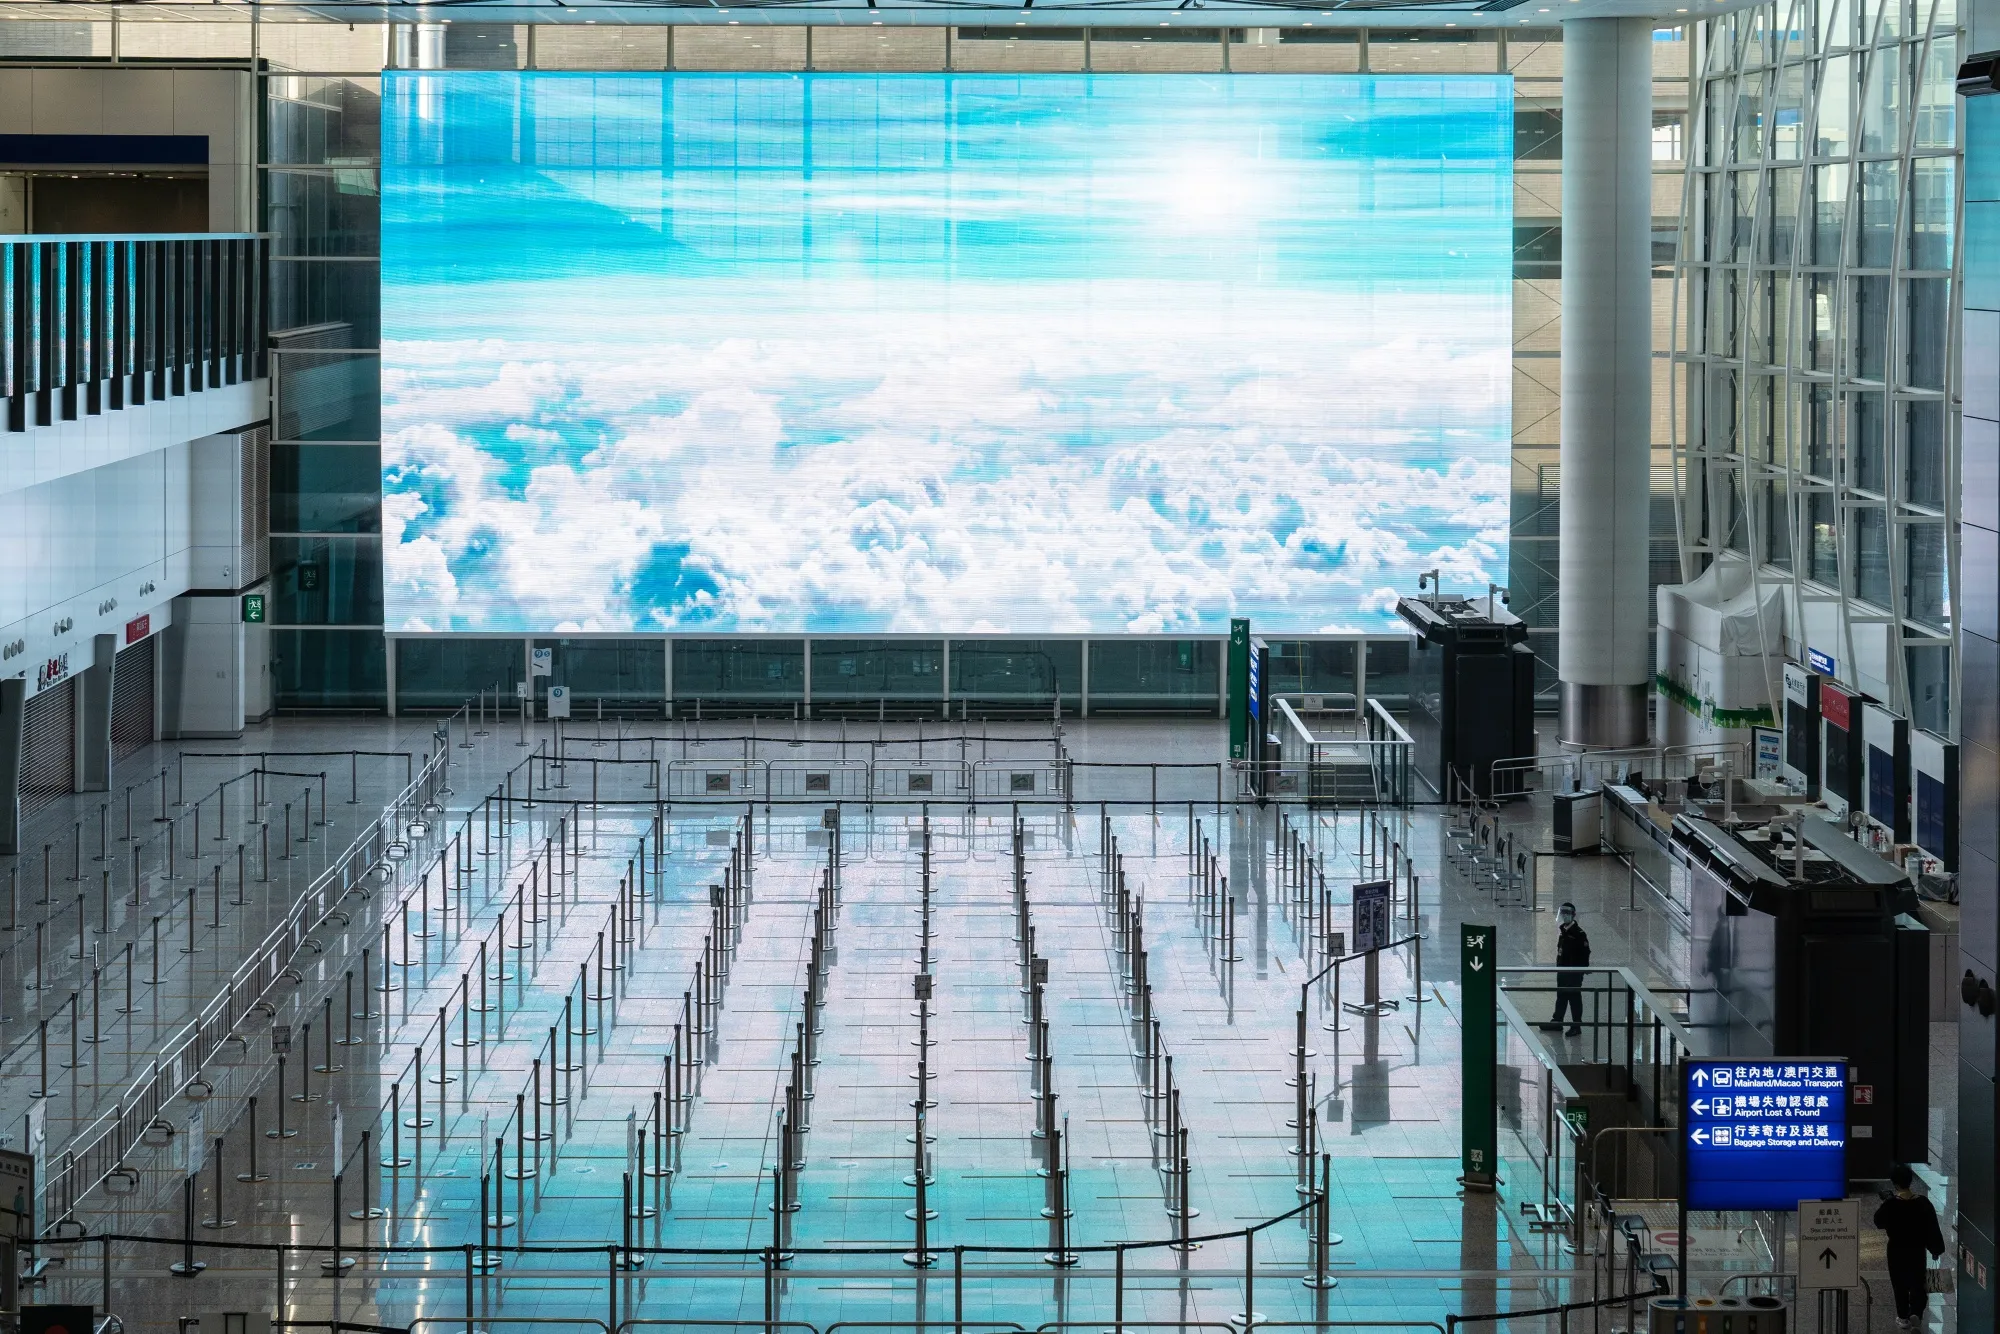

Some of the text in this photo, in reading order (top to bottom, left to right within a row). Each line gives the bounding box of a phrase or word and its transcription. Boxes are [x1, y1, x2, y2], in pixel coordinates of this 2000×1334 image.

[1734, 1079, 1843, 1088] Mainland/Macao Transport
[1735, 1095, 1829, 1107] 機場失物認領處
[1735, 1109, 1763, 1118] Airport
[1735, 1125, 1829, 1137] 行李寄存及送遞
[1734, 1138, 1844, 1147] Baggage Storage and Delivery
